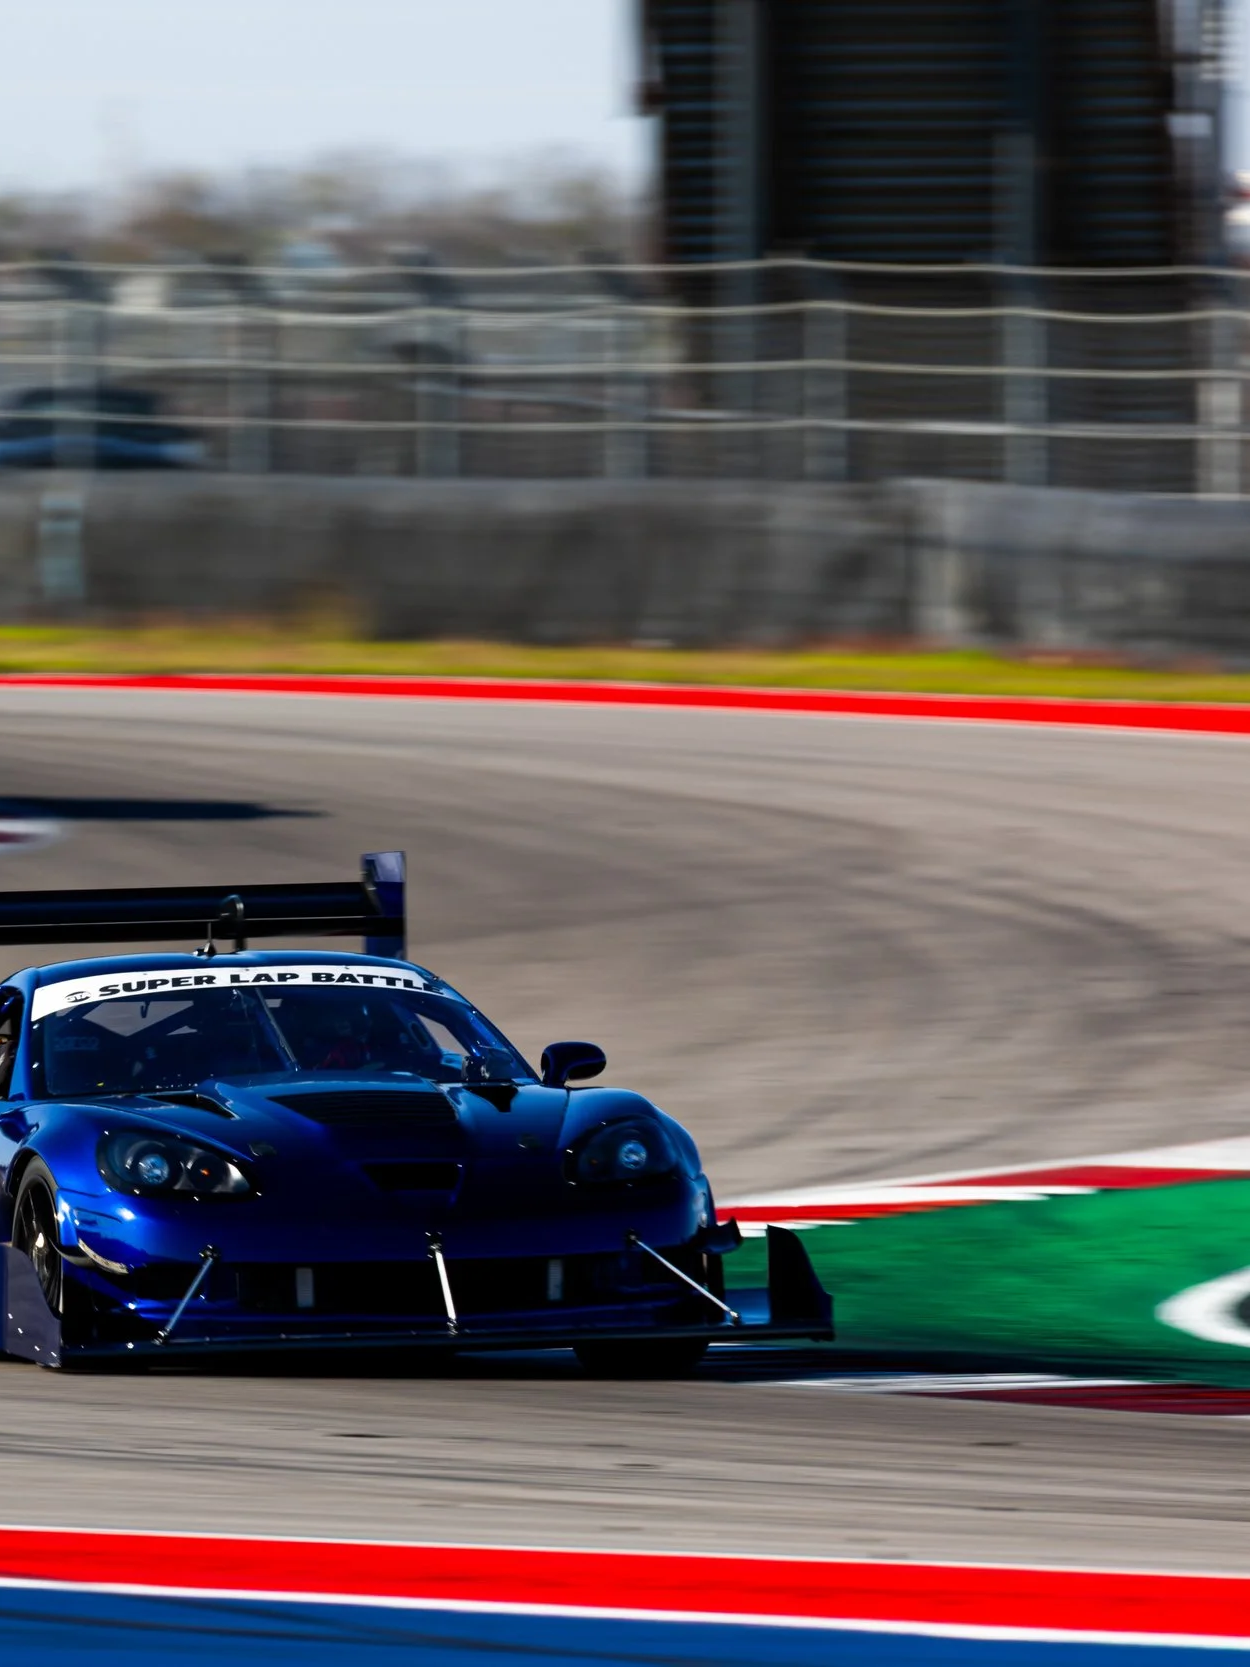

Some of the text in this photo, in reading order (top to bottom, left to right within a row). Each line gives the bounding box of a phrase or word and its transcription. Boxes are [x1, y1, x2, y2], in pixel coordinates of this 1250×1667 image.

[99, 972, 444, 997] SUPER LAP BATTLE
